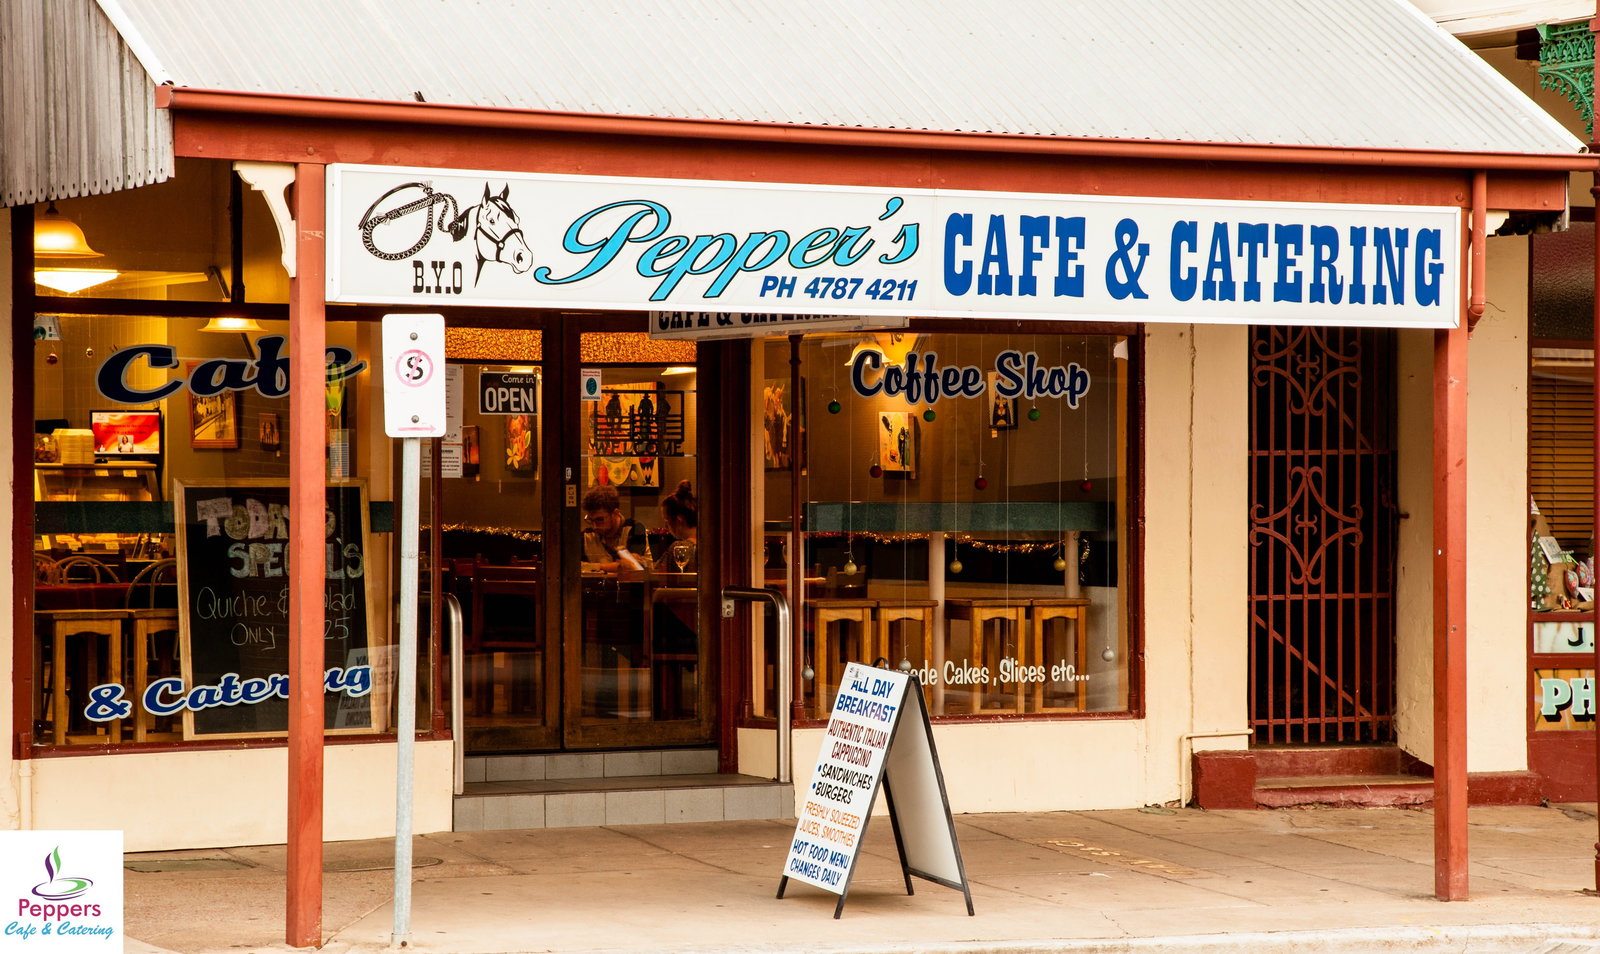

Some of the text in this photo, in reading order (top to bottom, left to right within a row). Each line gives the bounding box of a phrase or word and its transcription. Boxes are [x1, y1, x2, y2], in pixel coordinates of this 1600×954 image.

[534, 196, 919, 301] Pepper's
[943, 213, 1444, 307] CAFE & CATERING
[759, 276, 917, 301] PH 4787 4211
[501, 374, 535, 383] Come in
[851, 350, 1091, 409] Coffee Shop
[485, 387, 534, 412] OPEN
[197, 586, 271, 620] Quiche
[999, 657, 1046, 683] Slices
[1051, 659, 1089, 681] etc...
[84, 683, 132, 722] &
[142, 664, 374, 716] Caterng
[851, 676, 895, 698] ALL DAY
[836, 693, 896, 723] BREAKFAST
[828, 719, 889, 750] AUTHENTIC ITALIAN
[832, 741, 872, 768] CAPPUCCINO
[821, 763, 873, 790] SANDWICHES
[815, 781, 854, 804] BURGERS
[804, 801, 860, 829] FRESHLY SQUEEZED
[821, 826, 855, 847] SMOOTHIES
[792, 838, 851, 869] HOT FOOD MENU
[790, 858, 842, 886] CHANGES DAILY
